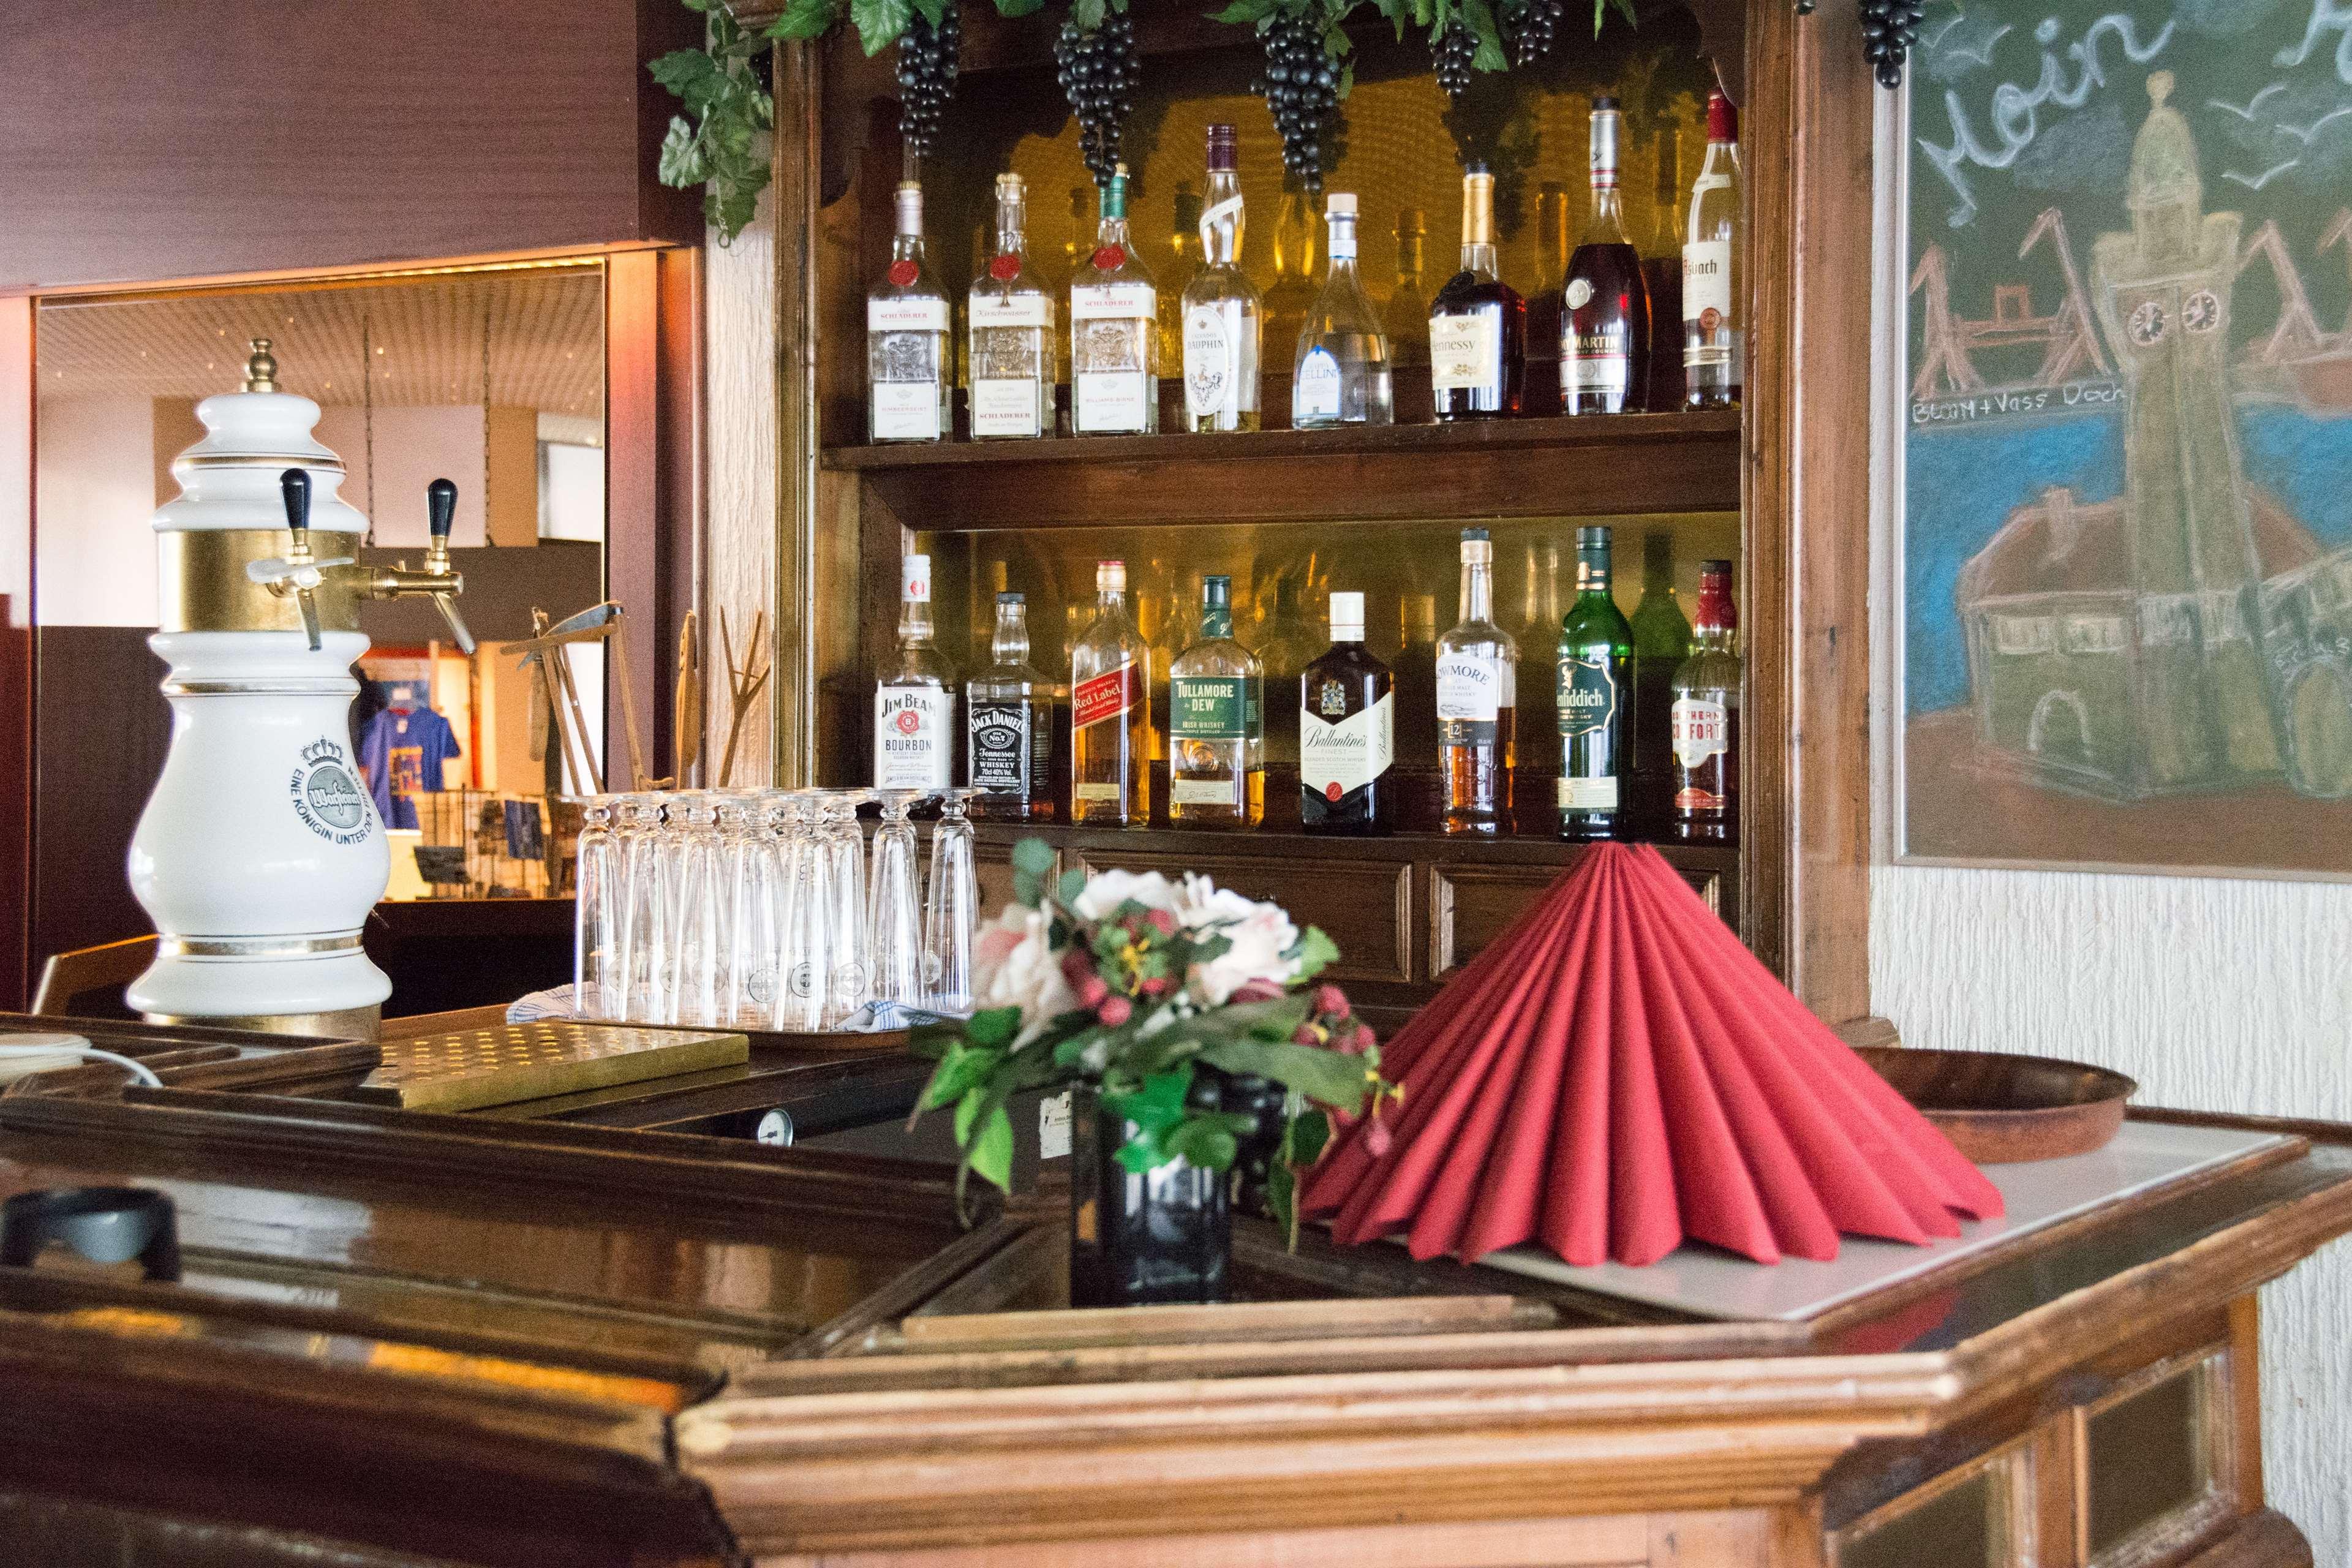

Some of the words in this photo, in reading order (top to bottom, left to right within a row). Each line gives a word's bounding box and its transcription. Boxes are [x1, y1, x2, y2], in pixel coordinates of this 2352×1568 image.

[1684, 258, 1717, 275] Asbach
[1188, 340, 1224, 350] DAUPHIN
[1431, 341, 1476, 353] Hennessy
[1574, 336, 1619, 349] MARTIN
[1436, 665, 1490, 685] OWMORE
[1074, 695, 1093, 710] Red
[1093, 684, 1121, 703] Label
[1176, 681, 1234, 698] TULLAMORE
[882, 698, 902, 718] JIM
[905, 693, 937, 717] BEAM
[1192, 699, 1215, 711] DEW
[971, 714, 992, 733] JACK
[1449, 724, 1461, 736] 12
[886, 739, 932, 751] BOURBON
[1304, 725, 1368, 748] Ballantine's
[979, 748, 1016, 758] Tennessee
[290, 768, 304, 796] EINE
[293, 798, 333, 841] KÖNIGIN
[336, 828, 368, 845] UNTER
